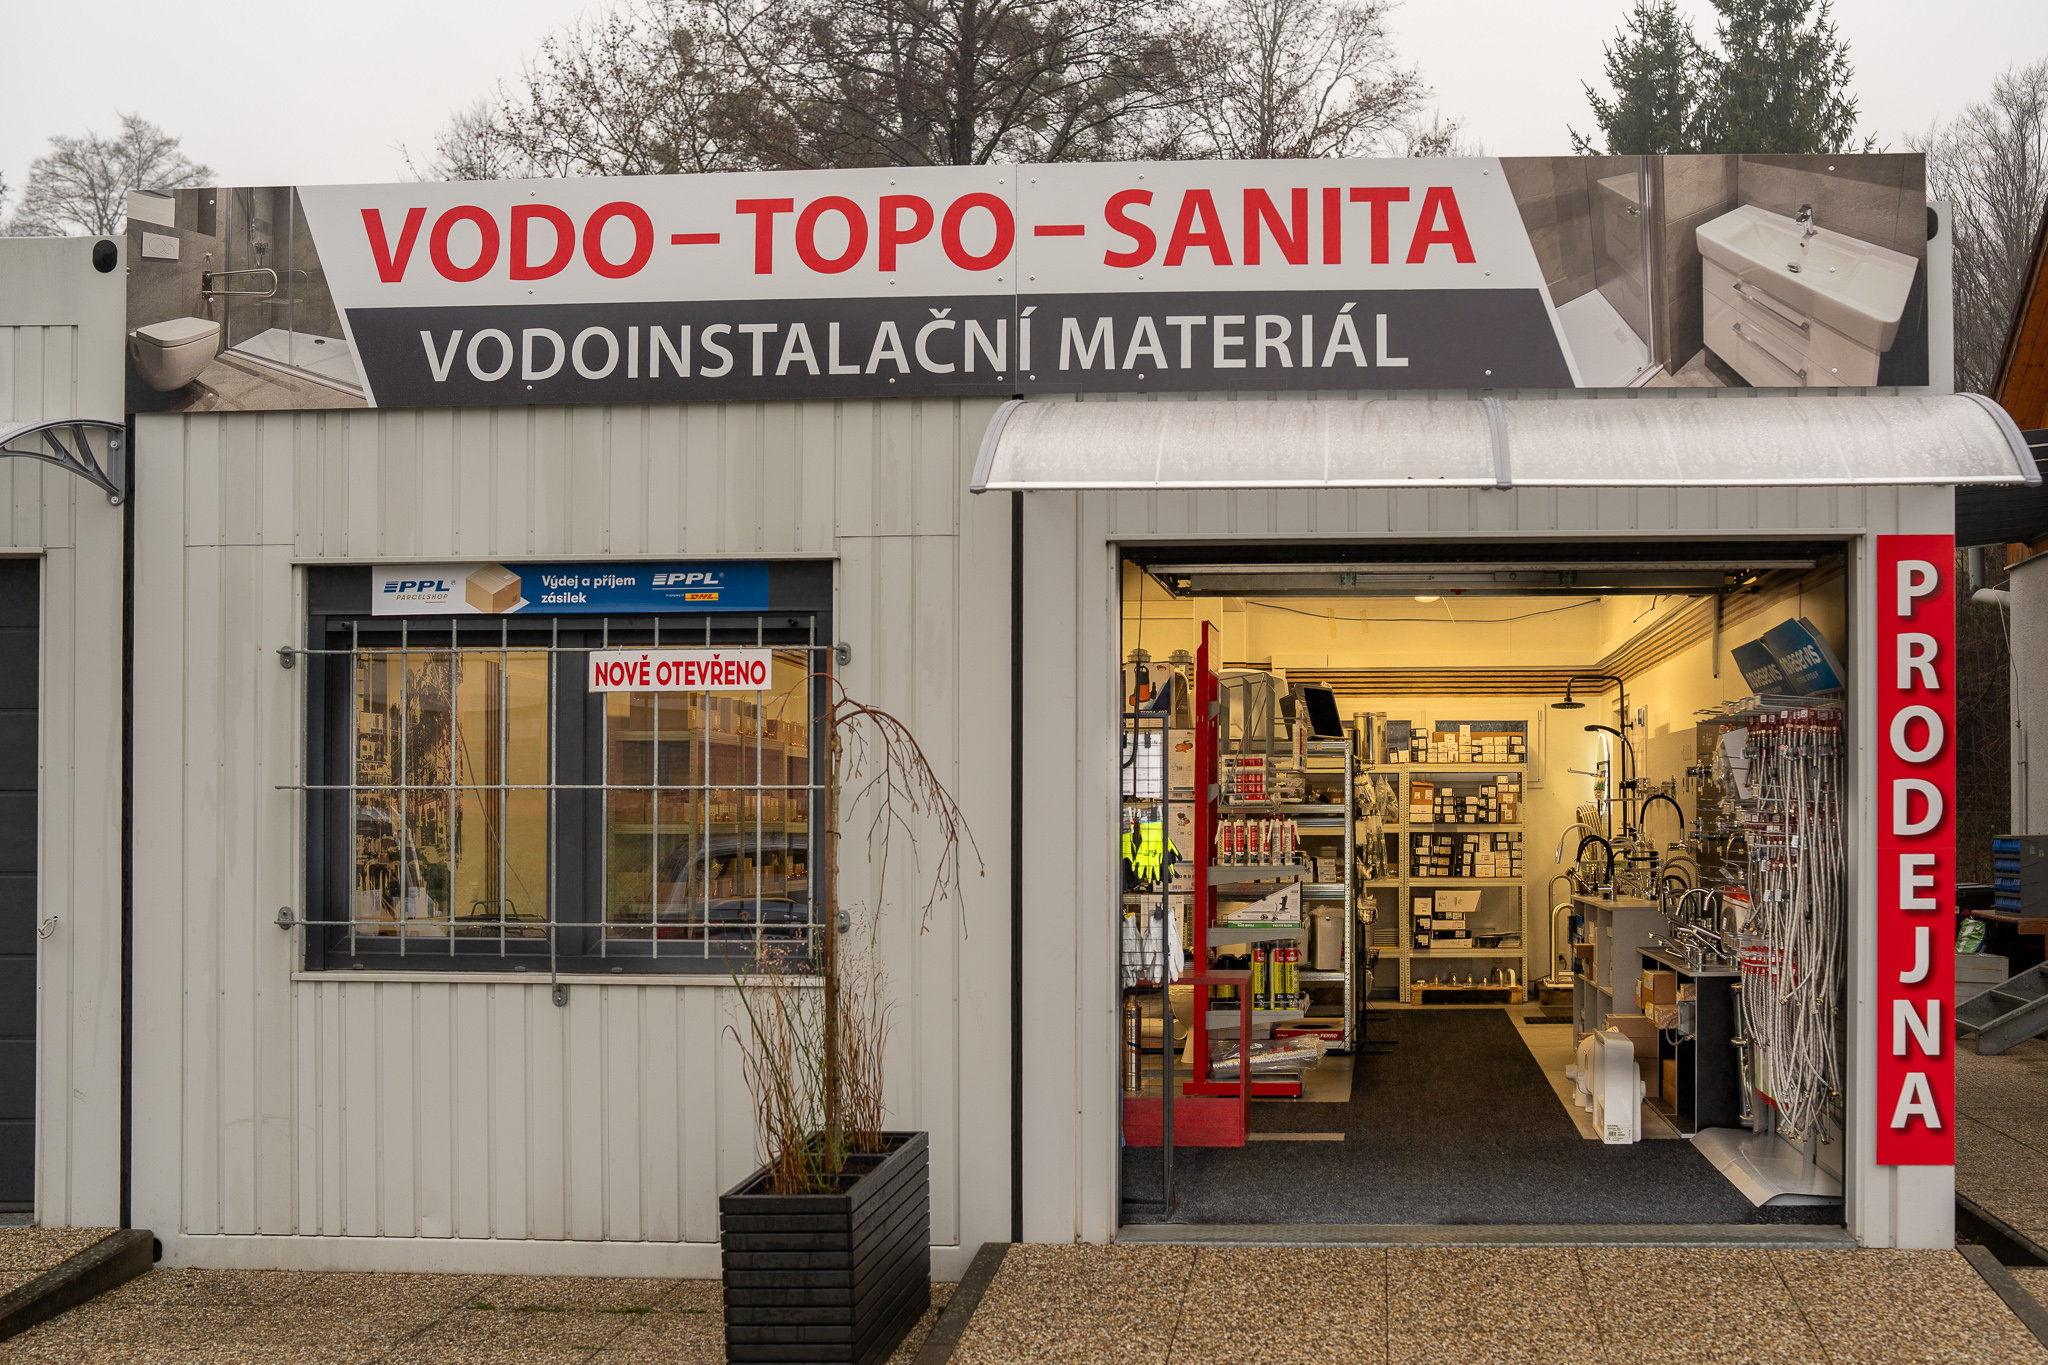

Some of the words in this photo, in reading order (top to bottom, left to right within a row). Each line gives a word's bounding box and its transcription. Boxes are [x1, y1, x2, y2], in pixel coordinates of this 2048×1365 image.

[361, 202, 655, 284] VODO
[736, 192, 1015, 275] TOPO
[1104, 186, 1476, 269] SANITA
[420, 306, 1036, 382] VODOINSTALAČNÍ
[1059, 303, 1409, 371] MATERIÁL
[398, 580, 450, 593] PPL
[541, 575, 579, 590] Výdej
[581, 579, 590, 587] a
[593, 574, 636, 589] příjem
[667, 572, 718, 585] PPL
[396, 593, 448, 601] PARCELSHOP
[541, 591, 587, 604] zásilek
[595, 654, 650, 687] NOVĚ
[656, 653, 767, 686] OTEVŘENO
[1778, 644, 1821, 675] novaservis
[1889, 559, 1945, 1130] PRODEJNA
